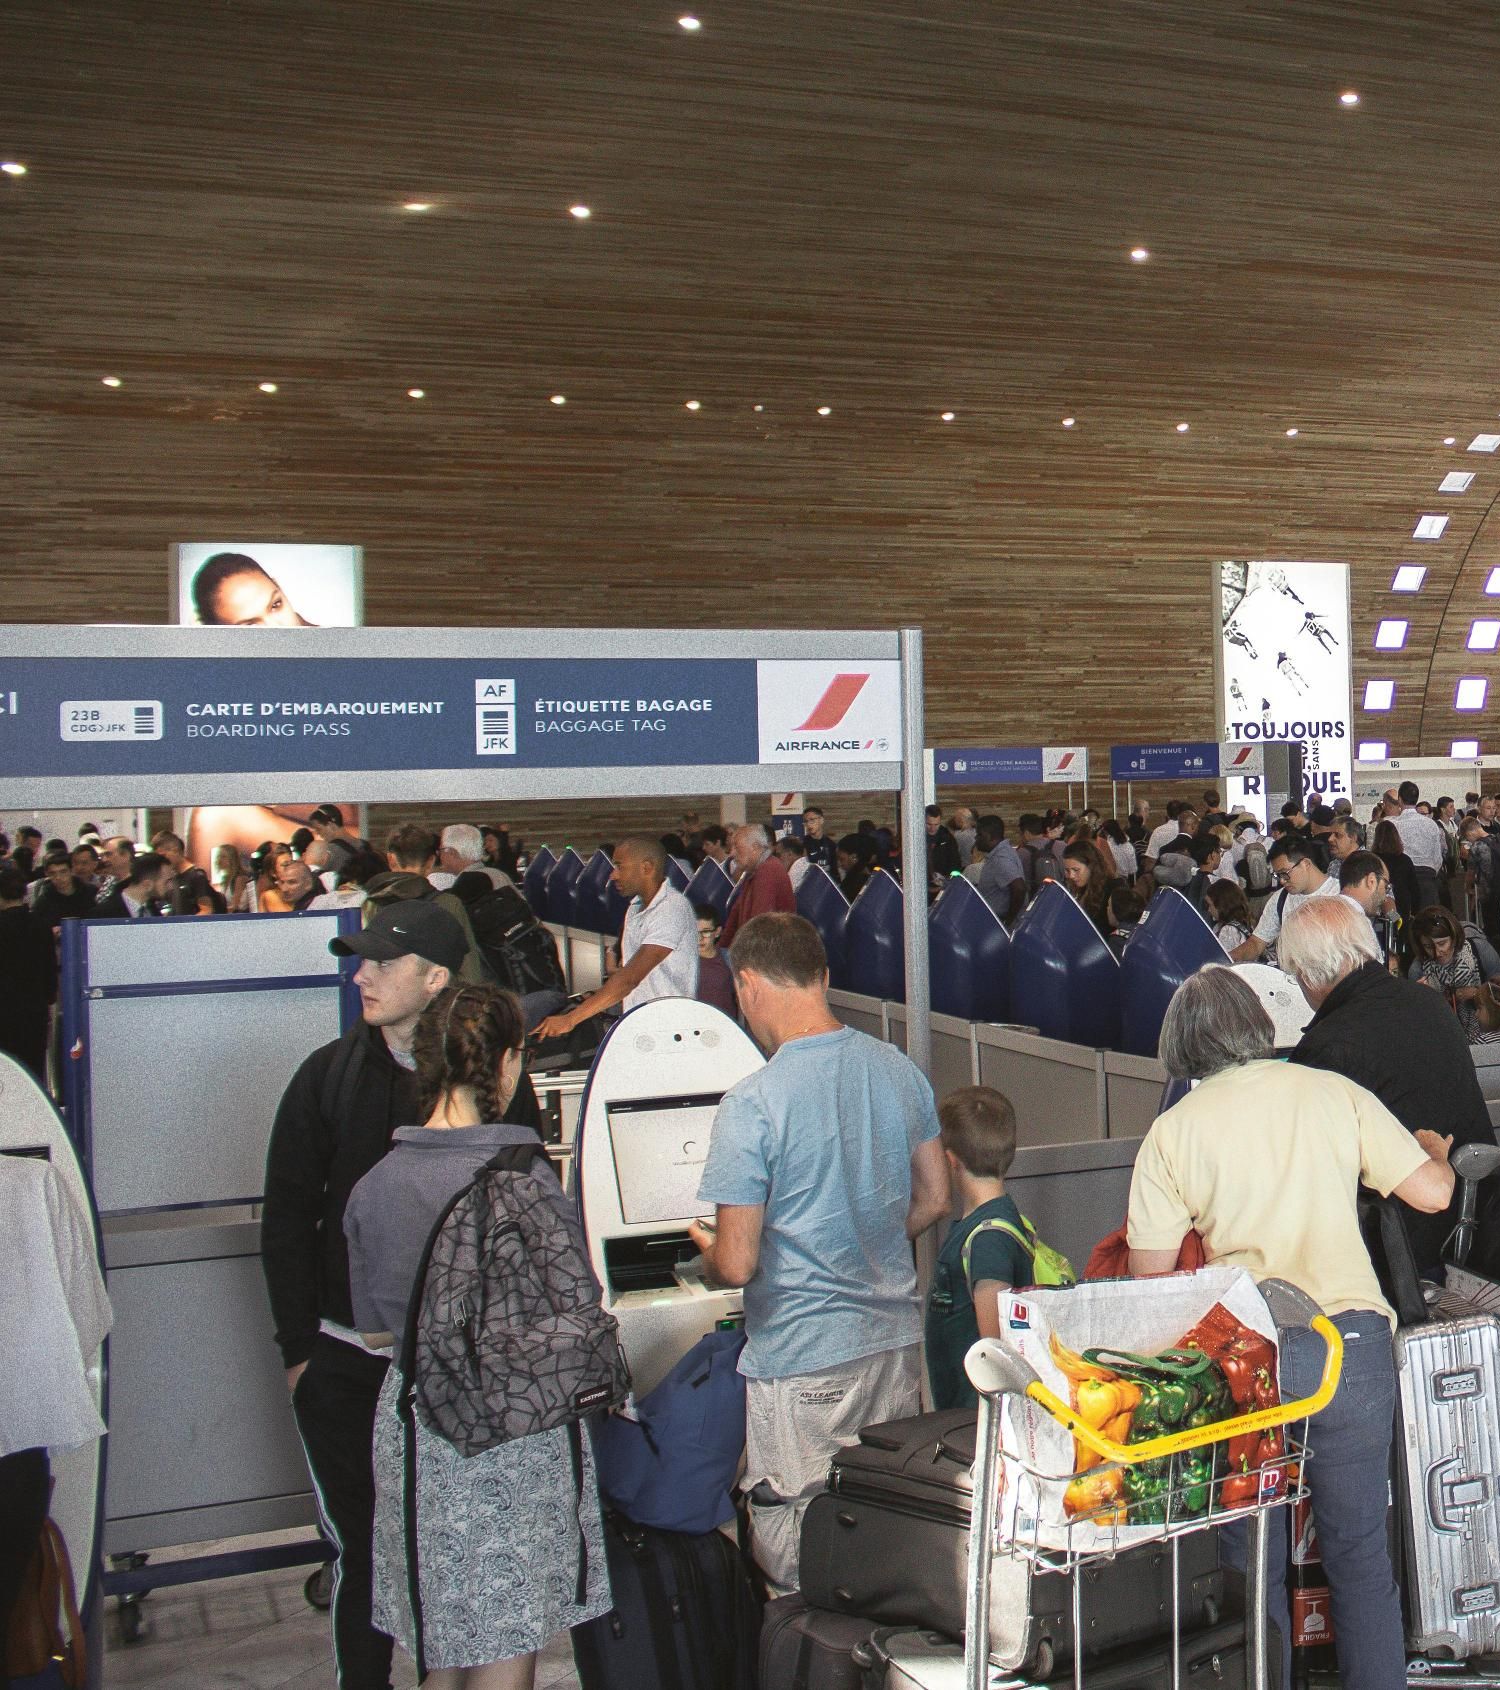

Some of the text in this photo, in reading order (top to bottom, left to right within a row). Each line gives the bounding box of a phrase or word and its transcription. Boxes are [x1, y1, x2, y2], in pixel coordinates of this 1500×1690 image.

[484, 685, 507, 697] AF
[186, 701, 445, 716] CARTE D'EMBARQUEMENT
[535, 699, 712, 713] ÉTIQUETTE BAGAGE
[71, 710, 100, 721] 23B
[187, 722, 350, 737] BOARDING PASS
[535, 719, 667, 733] BAGGAGE TAG
[1231, 721, 1345, 739] TOUJOURS
[483, 737, 509, 749] JFK
[775, 740, 860, 751] AIRFRANCE
[1312, 740, 1320, 770] SANS
[1298, 1632, 1330, 1642] FRAGILE
